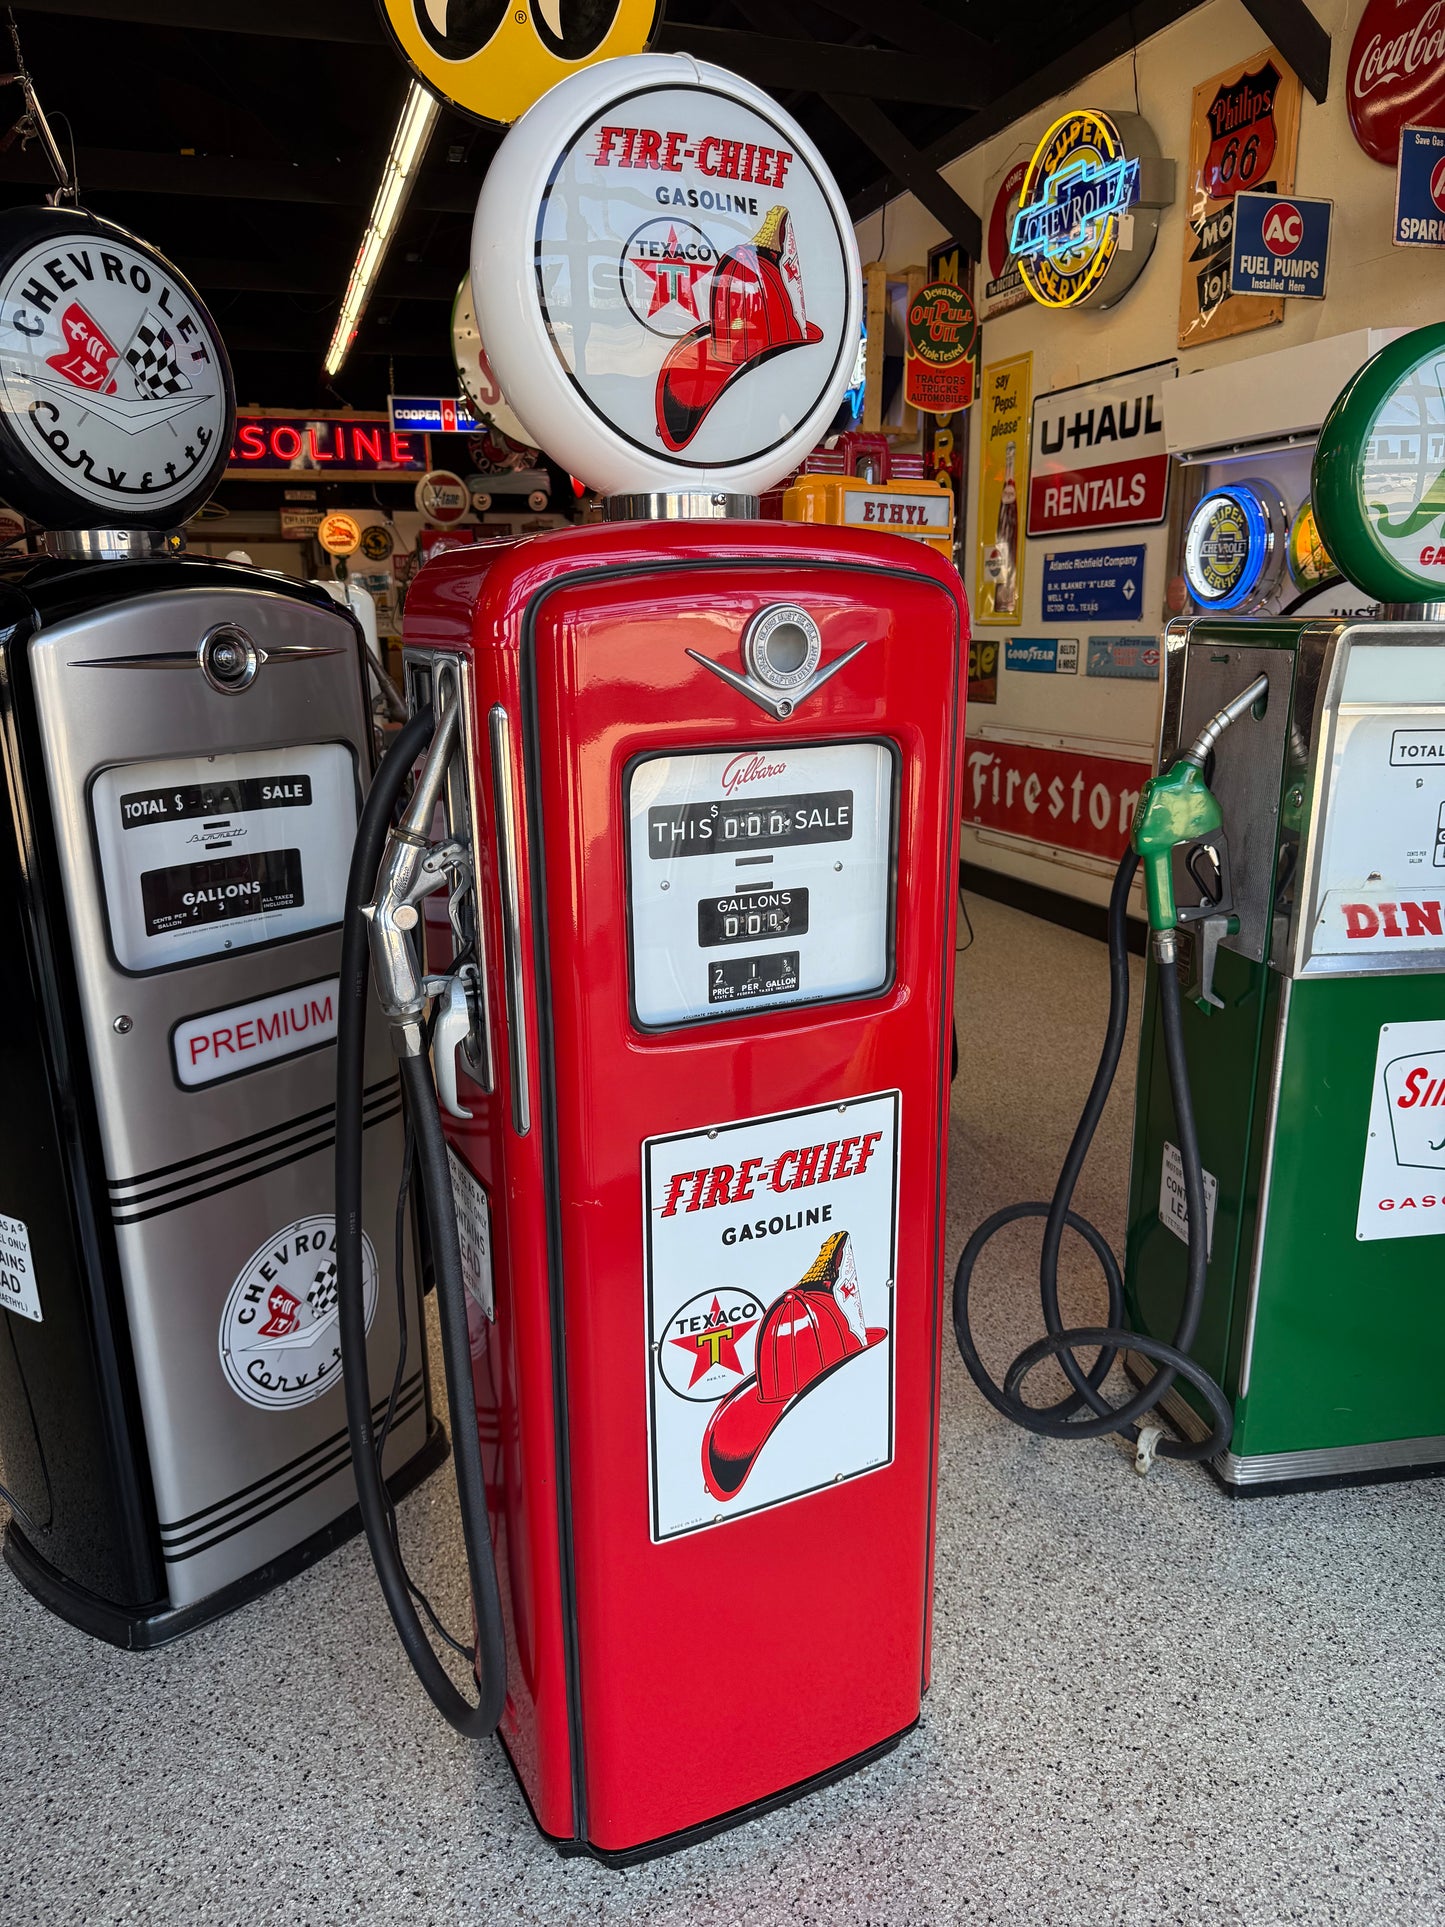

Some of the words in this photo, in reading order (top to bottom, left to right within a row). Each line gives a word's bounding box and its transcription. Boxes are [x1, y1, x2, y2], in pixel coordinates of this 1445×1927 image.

[1211, 85, 1271, 135] Phillips
[1044, 118, 1105, 176] SUPER
[1415, 133, 1430, 145] Save
[1432, 135, 1444, 146] Gas
[590, 126, 793, 189] FIRE-CHIEF
[1220, 134, 1261, 183] 66
[1005, 168, 1022, 192] HOME
[656, 186, 759, 216] GASOLINE
[1027, 177, 1132, 241] CHEVROLET
[1265, 214, 1301, 244] AC
[636, 240, 711, 262] TEXACO
[1039, 239, 1114, 301] SERVICE
[1240, 255, 1270, 275] FUEL
[1273, 258, 1319, 279] PUMPS
[657, 264, 689, 301] T
[1251, 277, 1284, 291] Installed
[1288, 280, 1306, 292] Here
[923, 287, 963, 303] Dewaxed
[13, 251, 211, 364] CHEVROLET
[917, 340, 938, 361] Triple
[939, 343, 964, 362] Tested
[915, 374, 966, 385] TRACTORS
[921, 384, 958, 394] TRUCKS
[995, 373, 1010, 390] say
[911, 393, 969, 404] AUTOMOBILES
[395, 409, 441, 421] COOPER
[28, 400, 213, 494] Corvette
[229, 424, 414, 462] SOLINE
[1043, 472, 1147, 519] RENTALS
[863, 501, 929, 526] ETHYL
[1049, 560, 1073, 571] Atlantic
[1074, 556, 1102, 569] Richfield
[1104, 556, 1138, 568] Company
[1097, 579, 1116, 588] LEASE
[1047, 594, 1062, 602] WELL
[1080, 603, 1099, 612] TEXAS
[1007, 646, 1054, 663] GOODYEAR
[1059, 644, 1076, 655] BELTS
[1062, 660, 1076, 669] HOSE
[721, 752, 787, 796] Gilbarco
[124, 797, 168, 819] TOTAL
[174, 793, 184, 812] $
[262, 784, 304, 800] SALE
[653, 818, 713, 842] THIS
[710, 804, 719, 818] $
[795, 806, 849, 829] SALE
[186, 828, 247, 843] Bennett
[182, 880, 261, 906] GALLONS
[263, 899, 294, 909] INCLUDED
[275, 893, 294, 901] TAXES
[717, 892, 792, 913] GALLONS
[152, 915, 172, 925] CENTS
[174, 912, 188, 921] PER
[157, 920, 183, 930] GALLON
[1341, 901, 1444, 939] DIN
[712, 986, 735, 996] PRICE
[741, 983, 759, 991] PER
[765, 976, 797, 988] GALLON
[715, 968, 724, 984] 2
[189, 996, 334, 1066] PREMIUM
[655, 1131, 883, 1218] FIRE-CHIEF
[1378, 1194, 1445, 1211] GAS
[11, 1224, 17, 1235] A
[722, 1204, 832, 1246] GASOLINE
[8, 1237, 27, 1252] ONLY
[676, 1302, 758, 1335] TEXACO
[696, 1326, 734, 1368] T
